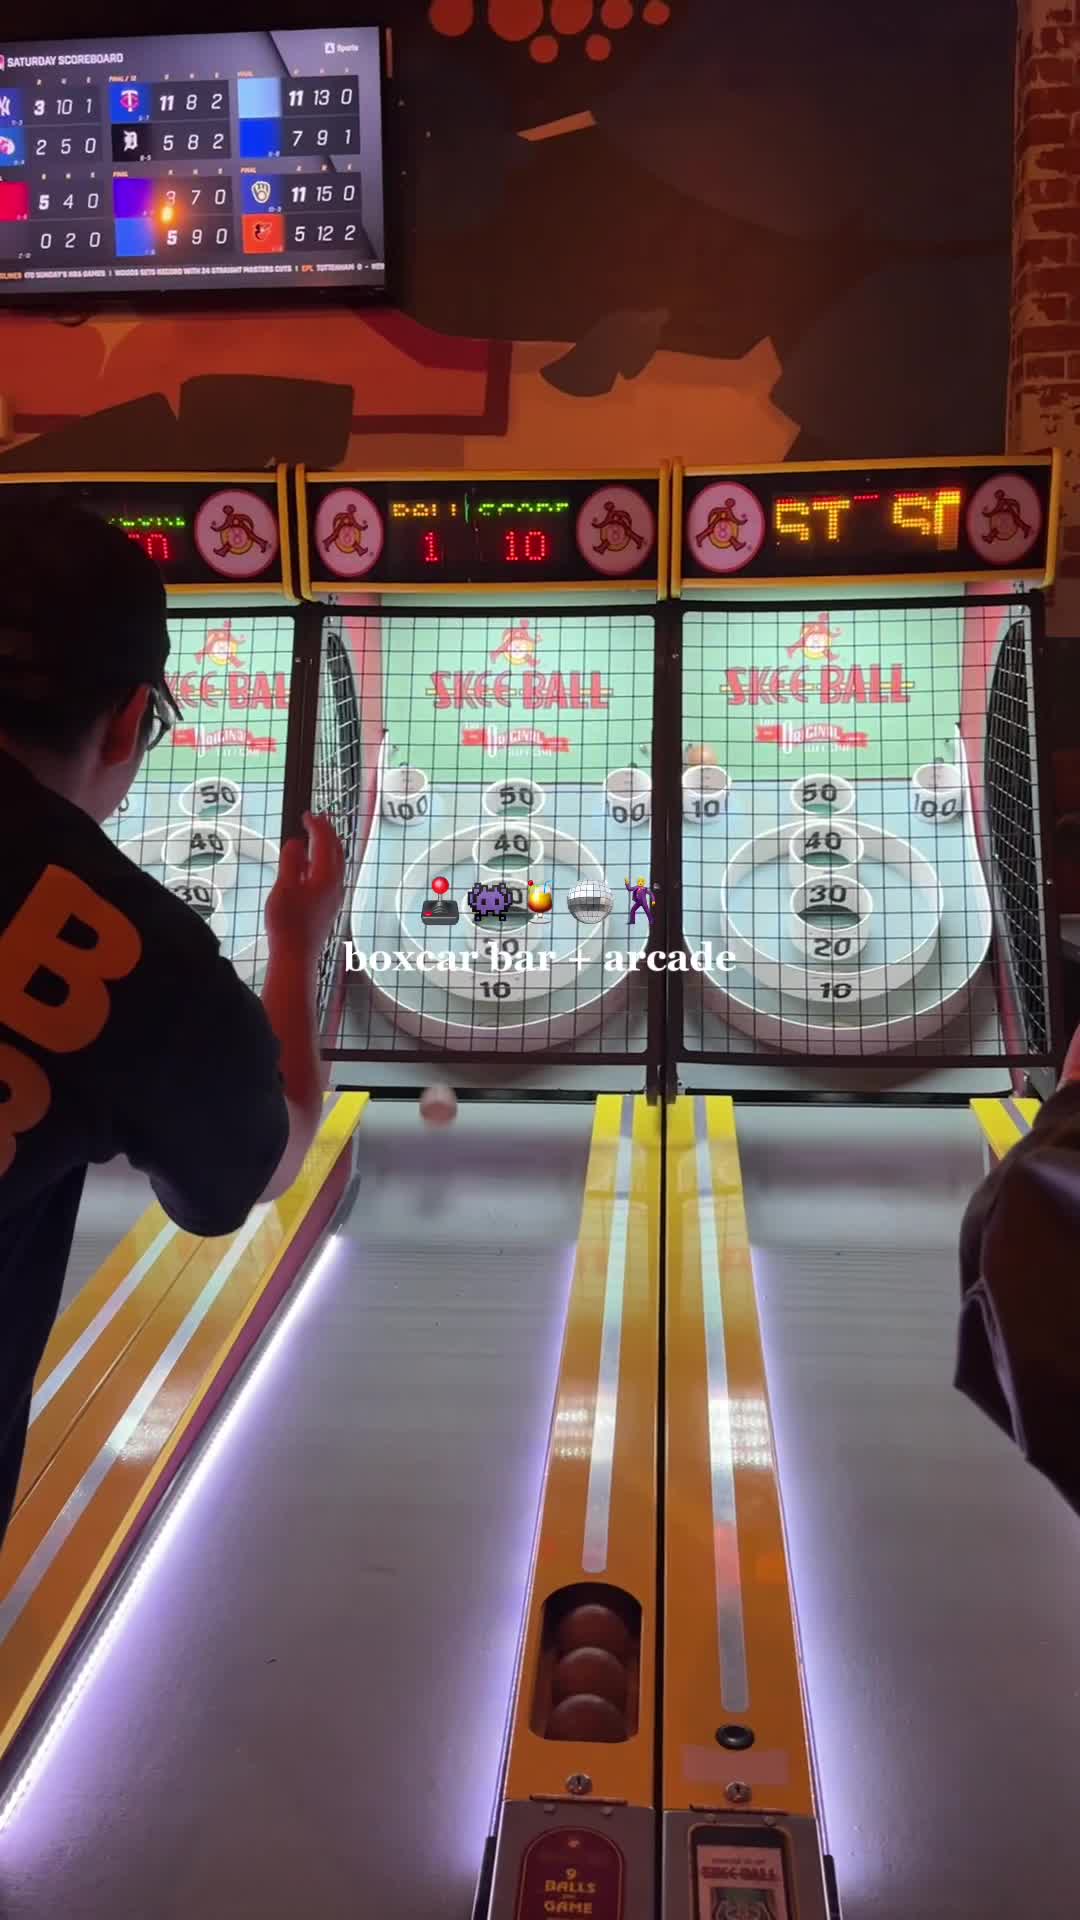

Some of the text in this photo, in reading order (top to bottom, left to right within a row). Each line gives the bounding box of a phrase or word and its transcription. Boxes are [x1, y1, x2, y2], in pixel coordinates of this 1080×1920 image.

[7, 53, 124, 67] SATURDAY SCOREBOARD
[34, 98, 92, 116] 3 10 1
[160, 93, 222, 112] 11 8 2
[289, 89, 352, 107] 11 13 0
[36, 137, 96, 155] 2 5 0
[163, 132, 224, 151] 5 8 2
[293, 129, 351, 147] 7 9 1
[39, 193, 99, 210] 5 4 0
[191, 190, 201, 206] 7
[215, 189, 226, 205] 0
[291, 184, 355, 202] 11 15 0
[40, 231, 101, 249] 0 2 0
[166, 228, 228, 246] 5 9 0
[294, 225, 356, 242] 5 12 2
[424, 531, 546, 562] 1 10
[164, 671, 290, 710] KEE BAL
[428, 671, 610, 710] SKEE BALL
[725, 663, 912, 706] SKEE BALL
[200, 785, 236, 804] 50
[500, 786, 534, 807] 50
[802, 783, 837, 803] 50
[386, 795, 428, 821] 100
[190, 833, 224, 851] 40
[494, 834, 529, 853] 40
[804, 831, 842, 851] 40
[173, 885, 210, 903] 30
[809, 884, 848, 904] 30
[813, 937, 851, 957] 20
[0, 863, 142, 1053] B
[480, 981, 512, 999] 10
[819, 981, 853, 999] 10
[544, 1879, 597, 1894] BALLS
[543, 1900, 593, 1914] GAME
